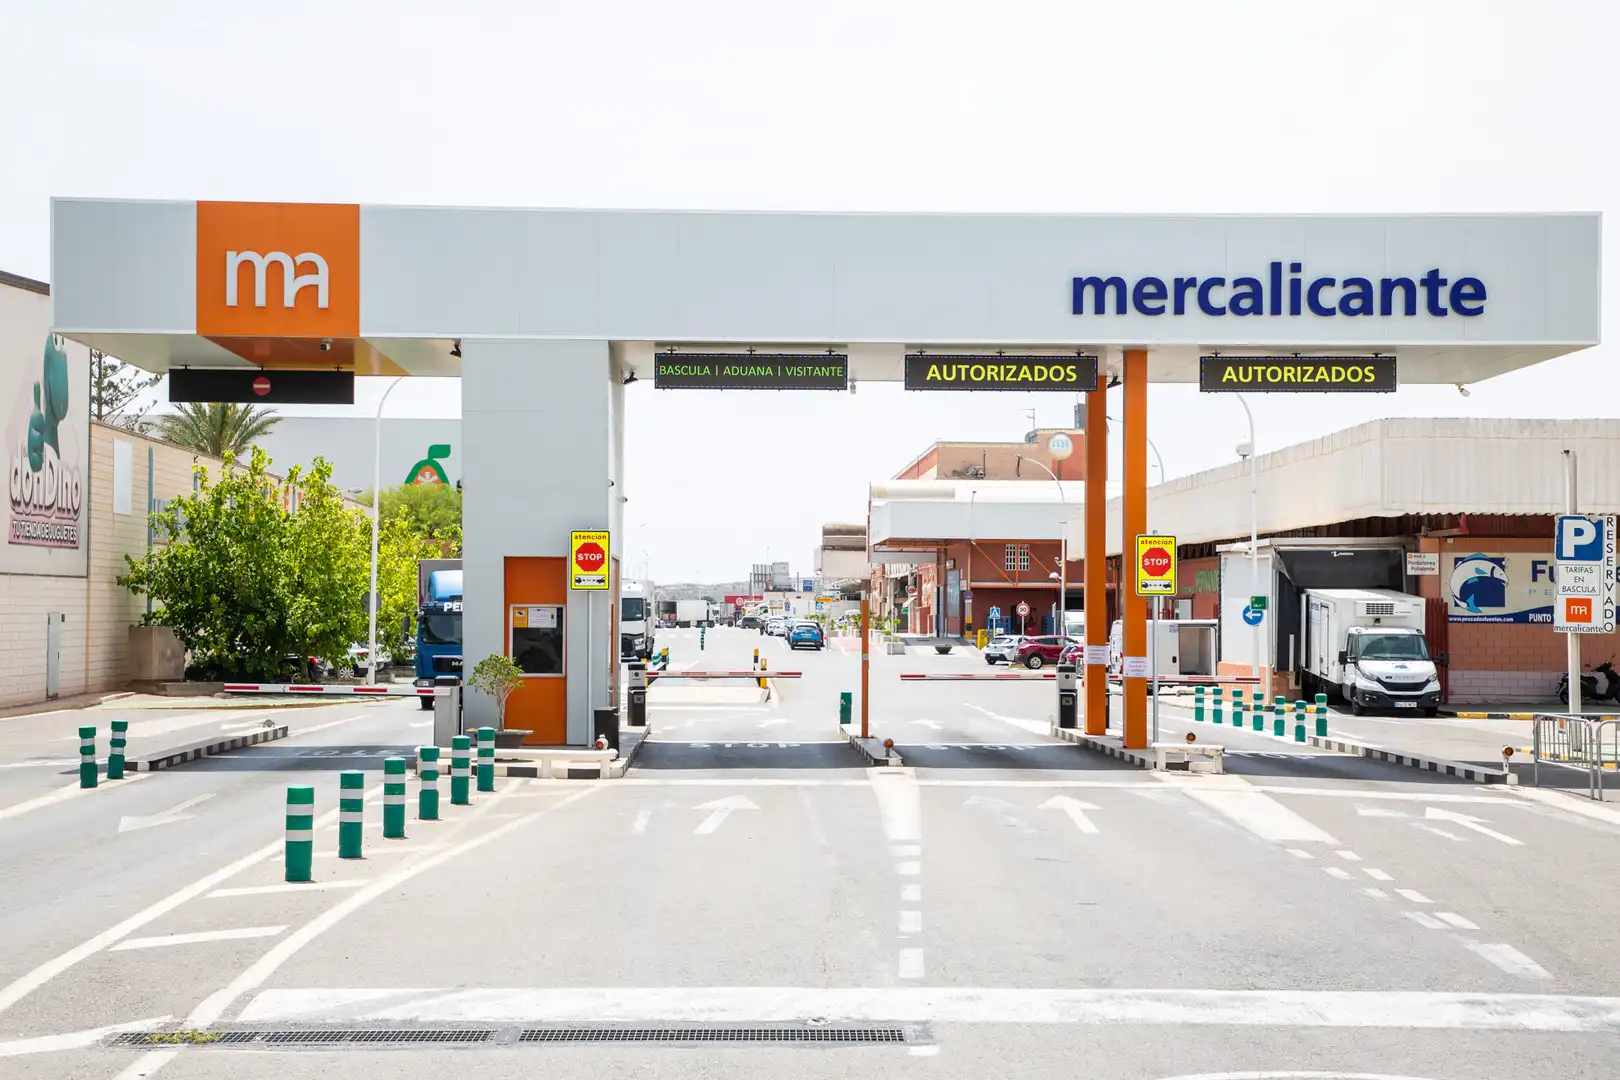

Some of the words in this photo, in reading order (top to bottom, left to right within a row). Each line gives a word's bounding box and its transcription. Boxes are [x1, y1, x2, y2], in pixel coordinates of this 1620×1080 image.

[226, 250, 329, 309] ma
[1072, 261, 1487, 317] mercalicante
[659, 365, 711, 376] BASCULA
[723, 365, 773, 377] ADUANA
[785, 366, 843, 377] VISITANTE
[926, 364, 1077, 382] AUTORIZADOS
[1222, 366, 1375, 383] AUTORIZADOS
[12, 520, 20, 538] TU
[577, 553, 603, 561] STOP
[1143, 558, 1169, 566] STOP
[1565, 566, 1594, 574] TARIFAS
[1603, 516, 1615, 633] RESERVADO
[1562, 585, 1597, 593] BASCULA
[1528, 613, 1552, 622] PUNTO
[1553, 624, 1603, 634] mercalicante
